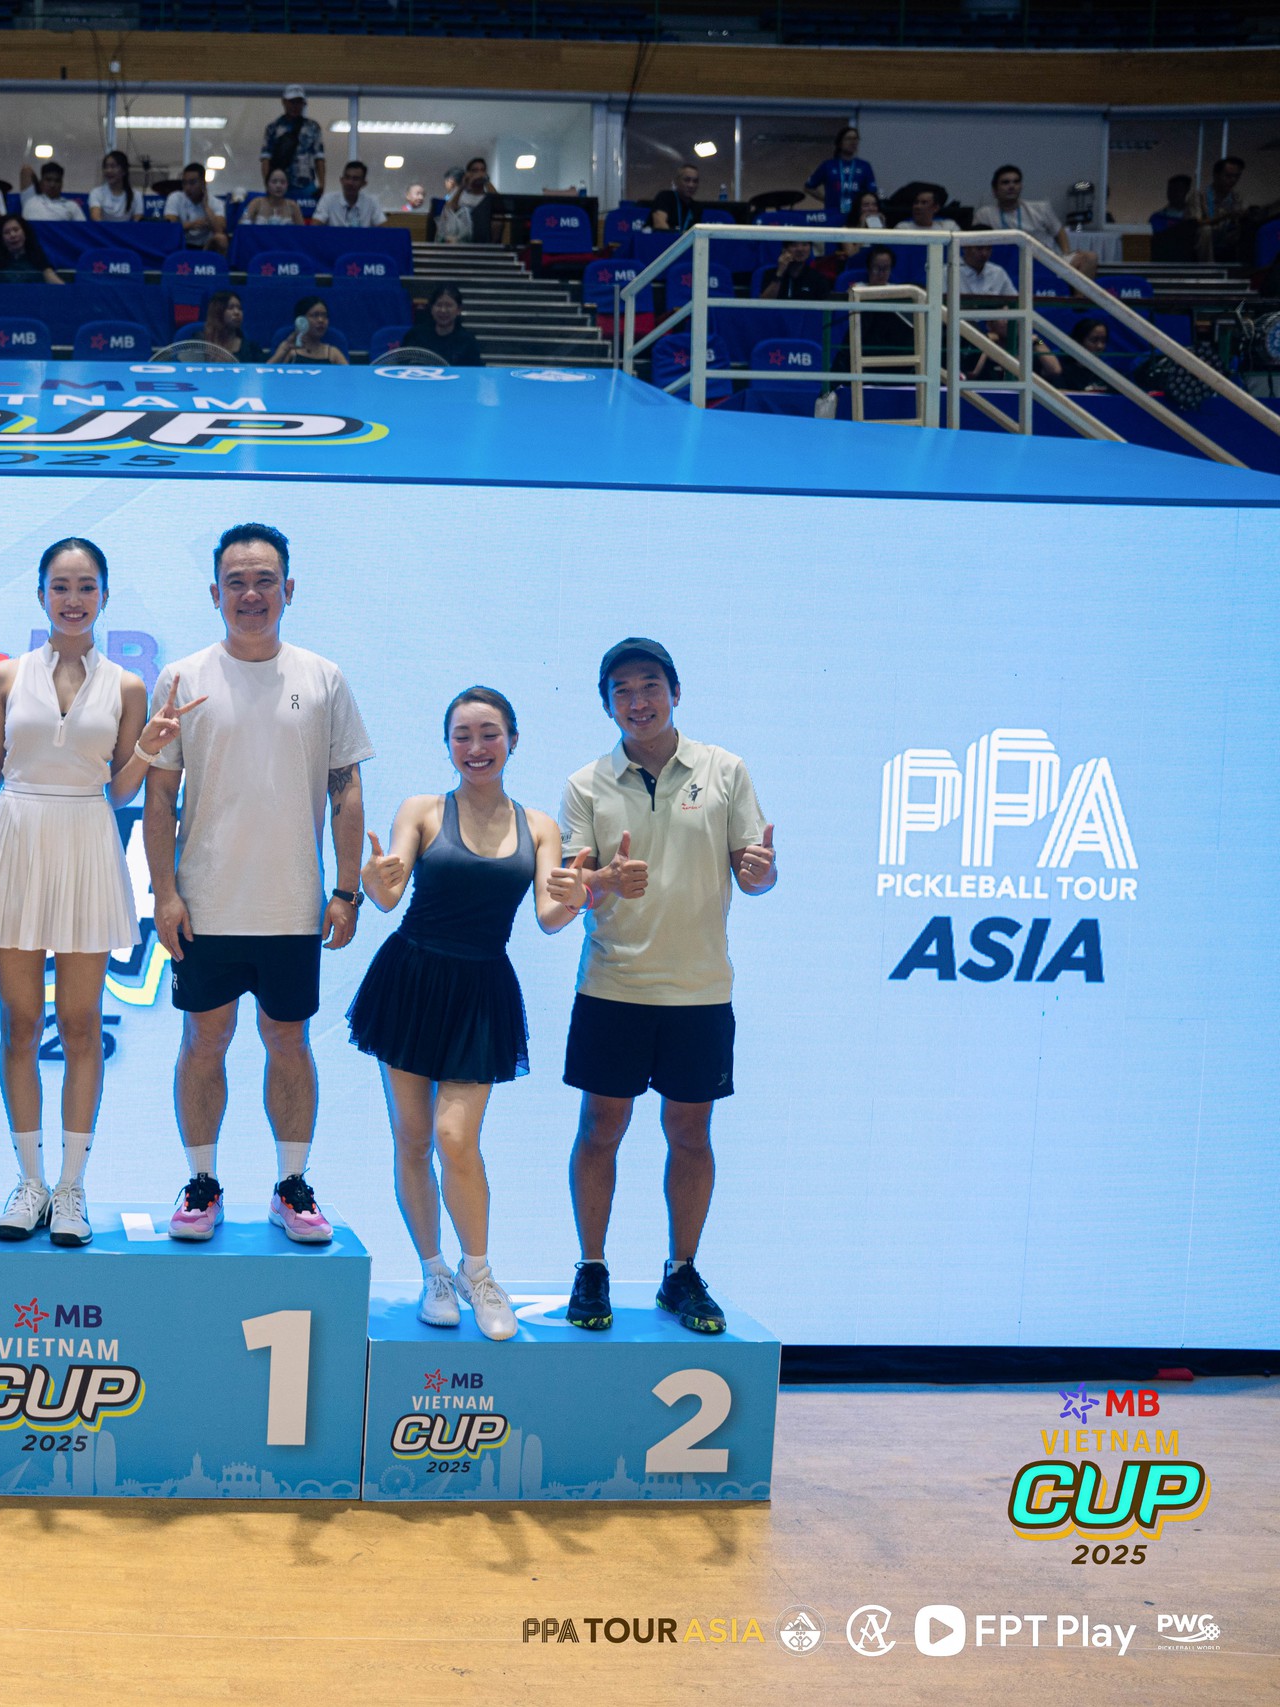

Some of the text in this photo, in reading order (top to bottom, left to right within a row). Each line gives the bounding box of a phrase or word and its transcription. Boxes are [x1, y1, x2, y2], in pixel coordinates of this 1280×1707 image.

[560, 217, 580, 228] MB
[806, 213, 827, 223] MB
[109, 262, 131, 275] MB
[277, 263, 299, 276] MB
[363, 264, 386, 276] MB
[614, 270, 636, 281] MB
[1121, 288, 1142, 299] MB
[12, 332, 37, 346] MB
[110, 335, 135, 349] MB
[788, 352, 813, 366] MB
[41, 378, 200, 393] MB
[878, 728, 1139, 869] PPA
[877, 873, 1138, 901] PICKLEBALL TOUR
[887, 915, 1105, 983] ASIA
[54, 1304, 103, 1329] MB
[241, 1310, 311, 1446] 1
[450, 1372, 484, 1390] MB
[412, 1396, 494, 1411] VIETNAM
[645, 1368, 731, 1473] 2
[21, 1434, 88, 1452] 2025
[390, 1413, 510, 1459] CUP
[426, 1461, 471, 1473] 2025
